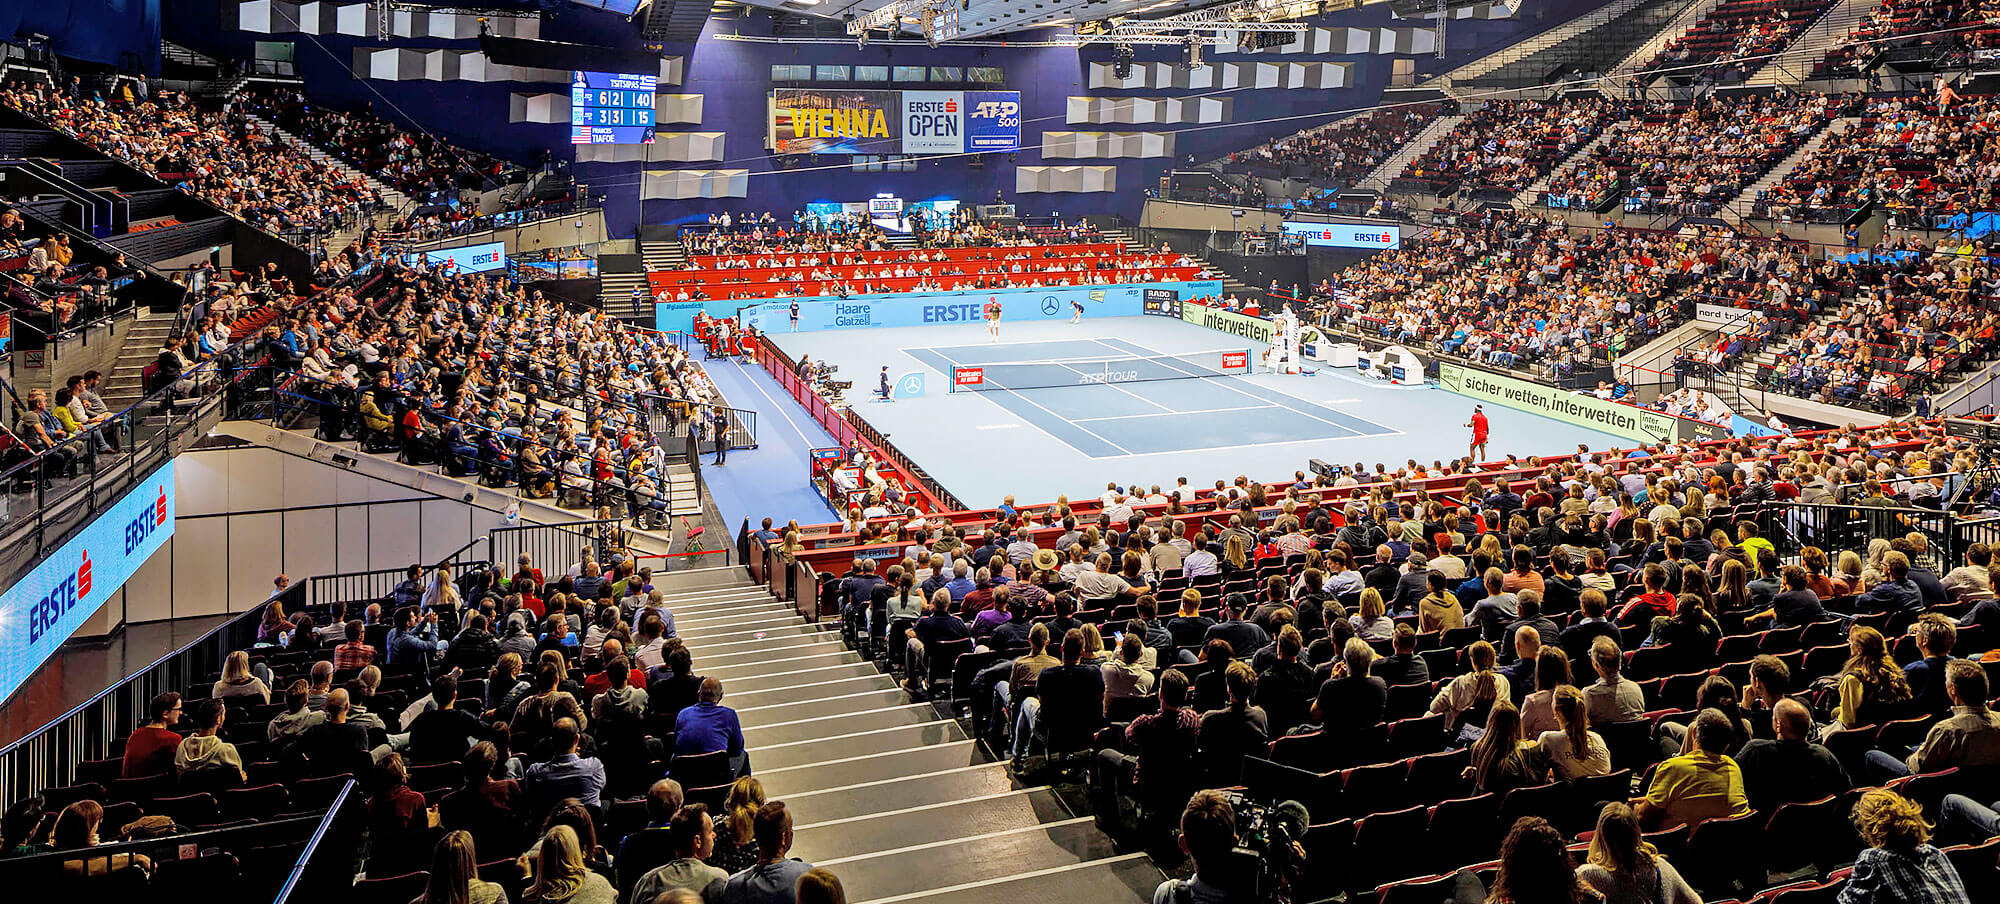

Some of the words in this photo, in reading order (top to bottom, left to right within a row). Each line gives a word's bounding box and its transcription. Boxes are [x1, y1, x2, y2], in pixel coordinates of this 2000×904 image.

[610, 79, 639, 89] TSITSIPAS
[600, 91, 607, 105] 6
[612, 92, 620, 105] 2
[637, 94, 650, 106] 40
[909, 101, 944, 113] ERSTE
[970, 101, 1018, 118] ATP
[600, 110, 607, 124] 3
[612, 110, 620, 124] 3
[638, 111, 648, 124] 15
[790, 108, 889, 138] VIENNA
[998, 118, 1018, 127] 500
[909, 115, 957, 137] OPEN
[592, 134, 615, 143] TIAFOE
[1354, 233, 1380, 242] ERSTE
[472, 253, 492, 265] ERSTE
[1147, 290, 1170, 298] RADO
[835, 303, 871, 315] Haare
[923, 303, 980, 323] ERSTE
[1699, 310, 1721, 318] nord
[1203, 307, 1269, 343] interwetten
[1106, 370, 1138, 382] TOUR
[1465, 376, 1501, 396] sicher
[1551, 393, 1636, 431] interwetten
[1642, 413, 1660, 425] inter
[1644, 423, 1668, 435] wetten
[1749, 424, 1764, 437] GLS
[125, 502, 155, 557] ERSTE
[30, 572, 76, 646] ERSTE
